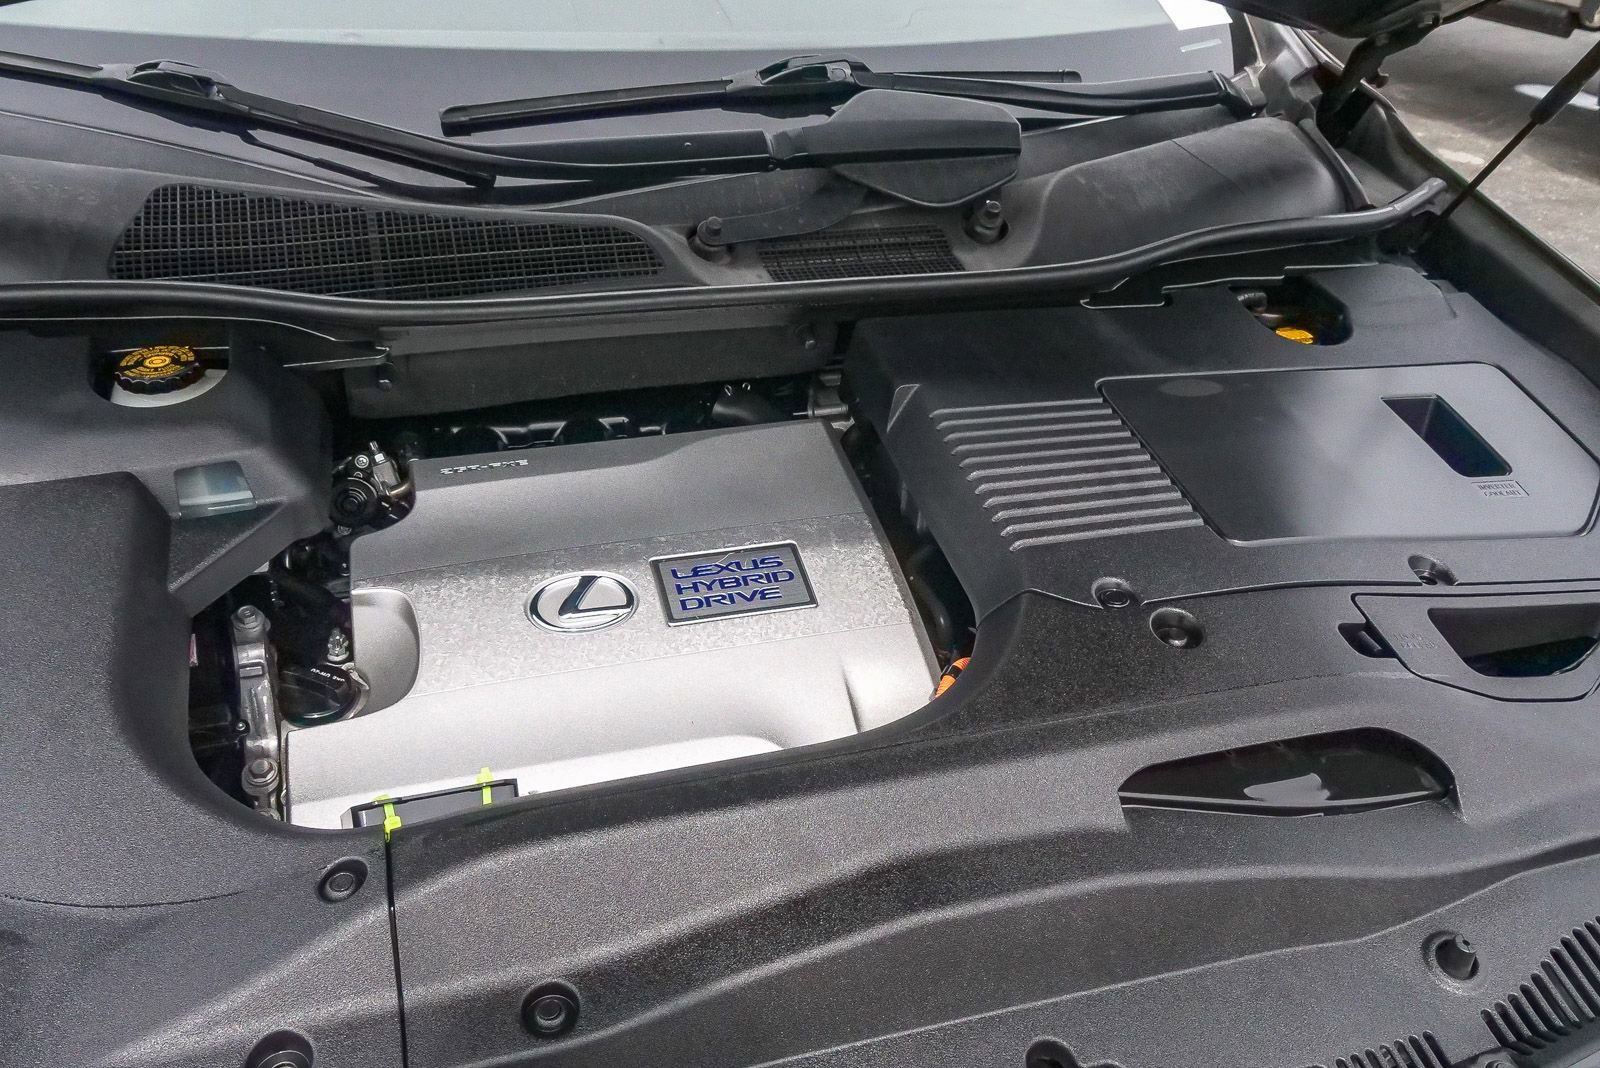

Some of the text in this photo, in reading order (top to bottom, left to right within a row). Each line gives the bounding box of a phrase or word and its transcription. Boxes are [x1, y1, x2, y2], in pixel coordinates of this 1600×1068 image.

[671, 555, 784, 579] LEXUS
[674, 568, 795, 595] HYBRID
[679, 585, 783, 611] DRIVE
